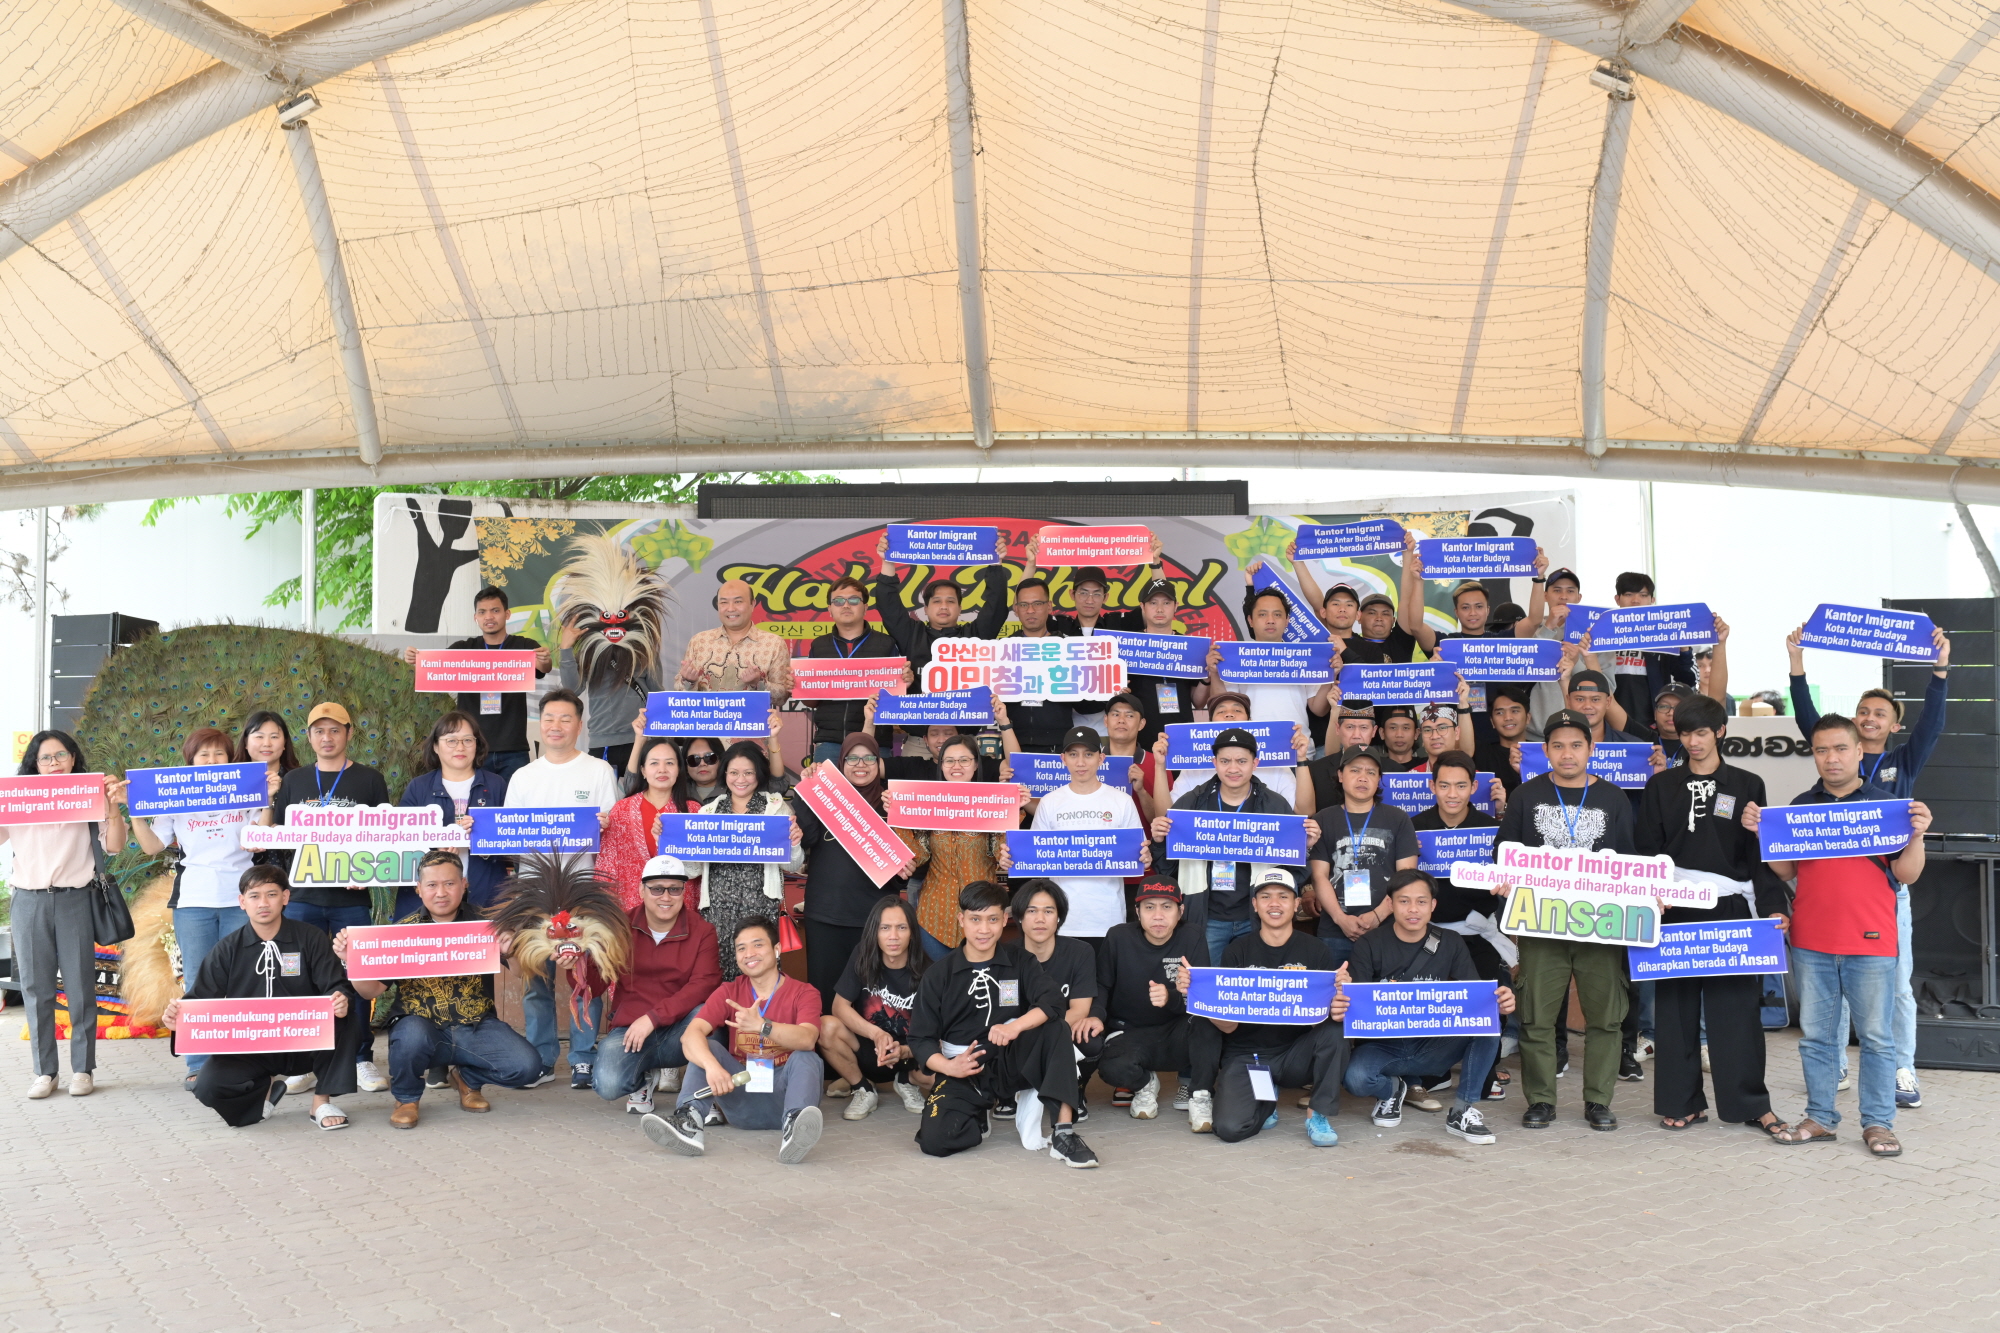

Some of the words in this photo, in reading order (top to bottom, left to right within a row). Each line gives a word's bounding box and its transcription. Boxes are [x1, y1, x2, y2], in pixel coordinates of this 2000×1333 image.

[1040, 535, 1061, 544] Kami
[1062, 535, 1109, 544] mendukung
[1110, 534, 1149, 544] pendirian
[1046, 547, 1075, 556] Kantor
[1076, 546, 1113, 558] Imigrant
[1114, 546, 1143, 555] Korea!
[1441, 542, 1473, 552] Kantor
[1474, 541, 1514, 553] Imigrant
[1443, 554, 1460, 563] Kota
[1461, 554, 1482, 562] Antar
[1483, 553, 1510, 564] Budaya
[1424, 564, 1465, 576] diharapkan
[1467, 564, 1493, 573] berada
[1494, 564, 1501, 573] di
[1502, 562, 1532, 572] Ansan
[1824, 608, 1864, 623] Kantor
[1864, 613, 1915, 630] Imigrant
[768, 624, 805, 638] 안산
[1824, 622, 1845, 633] Kota
[1846, 625, 1872, 636] Antar
[1873, 628, 1907, 642] Budaya
[1800, 632, 1849, 648] diharapkan
[1850, 637, 1883, 650] berada
[1884, 642, 1894, 652] di
[1894, 641, 1932, 656] Ansan
[937, 643, 996, 662] 안산의
[1000, 643, 1061, 662] 새로운
[1066, 642, 1112, 661] 도전!
[420, 659, 441, 668] Kami
[442, 659, 491, 670] mendukung
[492, 659, 531, 669] pendirian
[426, 671, 456, 681] Kantor
[458, 672, 495, 683] Imigrant
[496, 672, 525, 681] Korea!
[794, 668, 815, 677] Kami
[815, 667, 863, 677] mendukung
[865, 667, 903, 678] pendirian
[1048, 664, 1121, 695] 함께!
[800, 680, 830, 689] Kantor
[831, 679, 867, 690] Imigrant
[869, 678, 897, 688] Korea!
[154, 772, 192, 784] Kantor
[194, 768, 241, 783] Imigrant
[0, 785, 49, 799] endukung
[51, 784, 100, 798] pendirian
[157, 786, 178, 796] Kota
[179, 785, 204, 795] Antar
[205, 782, 237, 794] Budaya
[135, 798, 185, 810] diharapkan
[186, 795, 217, 806] berada
[218, 794, 227, 804] di
[228, 792, 262, 804] Ansan
[892, 791, 915, 801] Kami
[916, 792, 970, 805] mendukung
[971, 794, 1015, 805] pendirian
[8, 799, 54, 814] Imigrant
[57, 798, 93, 810] Korea!
[899, 805, 932, 816] Kantor
[933, 806, 974, 819] Imigrant
[976, 808, 1008, 819] Korea!
[187, 819, 219, 832] Sports
[220, 812, 244, 824] Club
[291, 810, 354, 826] Kantor
[358, 809, 437, 830] Imigrant
[817, 769, 835, 789] Kami
[832, 788, 871, 832] mendukung
[867, 829, 902, 865] pendirian
[1193, 816, 1231, 829] Kantor
[1232, 818, 1280, 833] Imigrant
[684, 819, 719, 830] Kantor
[721, 819, 765, 833] Imigrant
[811, 784, 837, 812] Kantor
[833, 809, 866, 845] Imigrant
[861, 841, 889, 870] Korea!
[247, 831, 273, 842] Kota
[276, 831, 308, 842] Antar
[310, 831, 352, 845] Budaya
[355, 831, 419, 844] diharapkan
[422, 830, 457, 841] berada
[687, 833, 705, 842] Kota
[706, 833, 729, 843] Antar
[730, 834, 761, 845] Budaya
[1033, 835, 1069, 845] Kantor
[1071, 834, 1117, 847] Imigrant
[1195, 831, 1215, 841] Kota
[1216, 832, 1241, 842] Antar
[1242, 833, 1274, 846] Budaya
[1361, 836, 1386, 849] KOREA
[1036, 849, 1055, 858] Kota
[1056, 848, 1080, 858] Antar
[1081, 847, 1113, 860] Budaya
[1172, 842, 1221, 855] diharapkan
[1223, 845, 1253, 856] berada
[1254, 846, 1263, 856] di
[1264, 845, 1299, 859] Ansan
[293, 844, 425, 883] Ansan
[1015, 860, 1061, 872] diharapkan
[1063, 860, 1093, 870] berada
[1094, 860, 1103, 870] di
[1104, 859, 1138, 870] Ansan
[1505, 848, 1572, 871] Kantor
[1578, 854, 1667, 880] Imigrant
[1457, 868, 1485, 882] Kota
[1487, 870, 1522, 885] Antar
[1525, 874, 1571, 891] Budaya
[1574, 878, 1646, 898] diharapkan
[1650, 884, 1695, 900] berada
[1698, 888, 1711, 901] di
[1505, 887, 1655, 943] Ansan
[352, 938, 379, 950] Kami
[381, 936, 442, 948] mendukung
[444, 933, 494, 947] pendirian
[360, 954, 399, 965] Kantor
[400, 951, 448, 965] Imigrant
[450, 948, 486, 961] Korea!
[1215, 974, 1255, 987] Kantor
[1257, 975, 1308, 991] Imigrant
[1218, 990, 1239, 1001] Kota
[1240, 990, 1267, 1002] Antar
[1268, 991, 1302, 1005] Budaya
[1372, 989, 1413, 1001] Kantor
[1415, 988, 1468, 1003] Imigrant
[182, 1012, 210, 1023] Kami
[212, 1011, 275, 1023] mendukung
[277, 1009, 329, 1023] pendirian
[1193, 1000, 1245, 1015] diharapkan
[1247, 1004, 1280, 1016] berada
[1281, 1005, 1291, 1016] di
[1292, 1004, 1328, 1017] Ansan
[1375, 1005, 1398, 1015] Kota
[1399, 1004, 1426, 1015] Antar
[1427, 1003, 1463, 1016] Budaya
[1351, 1018, 1405, 1032] diharapkan
[1407, 1017, 1440, 1029] berada
[1442, 1016, 1452, 1028] di
[1453, 1015, 1492, 1027] Ansan
[190, 1028, 230, 1039] Kantor
[231, 1027, 281, 1040] Imigrant
[283, 1025, 320, 1037] Korea!
